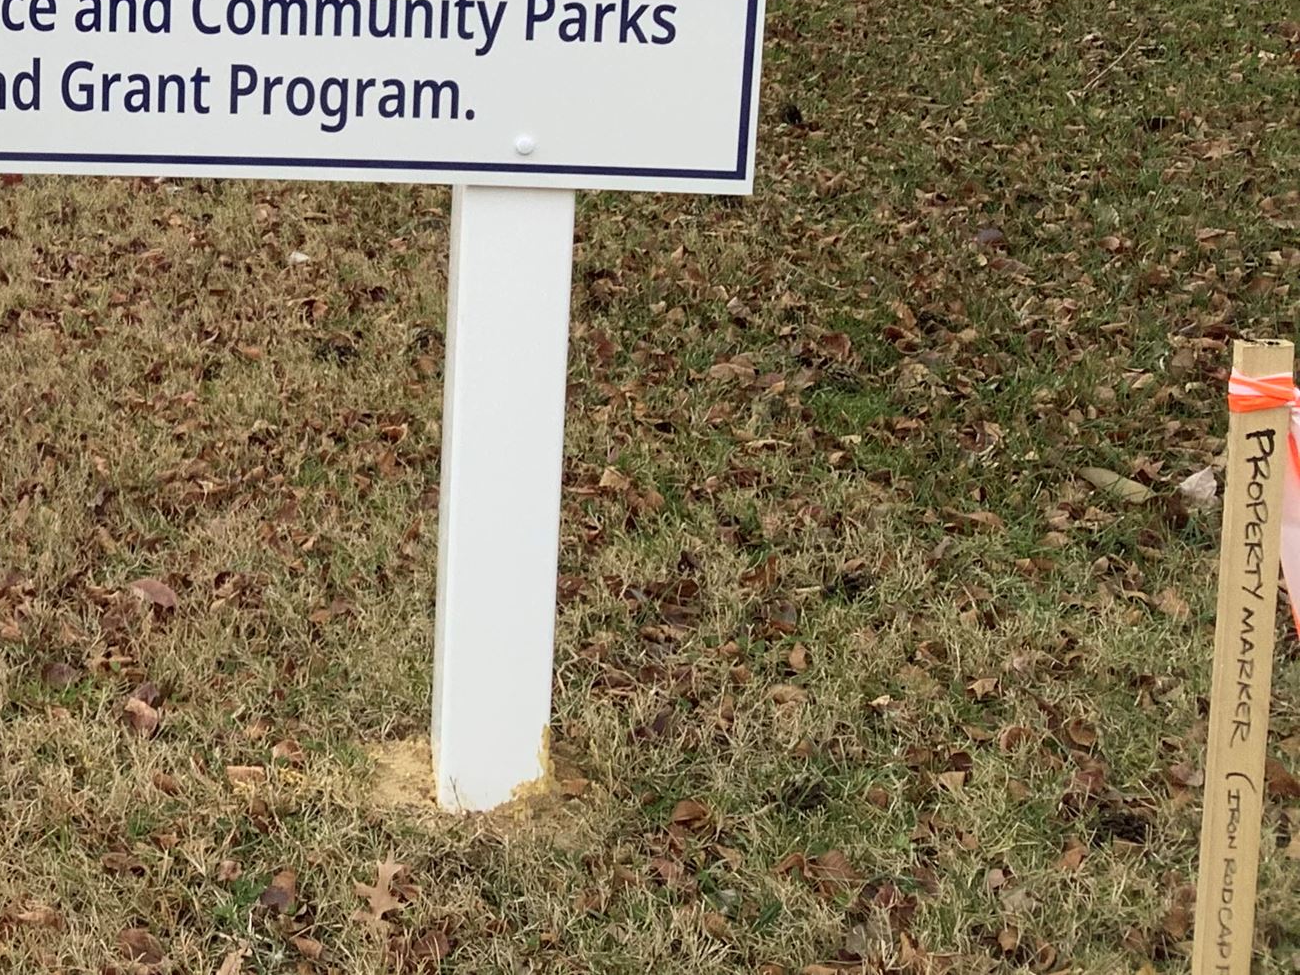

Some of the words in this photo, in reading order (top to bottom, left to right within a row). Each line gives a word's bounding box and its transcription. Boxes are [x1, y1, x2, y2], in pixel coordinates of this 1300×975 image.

[61, 61, 211, 115] Grant
[230, 63, 477, 131] Program.
[1242, 427, 1276, 600] PROPERTY
[1229, 606, 1254, 748] MARKER
